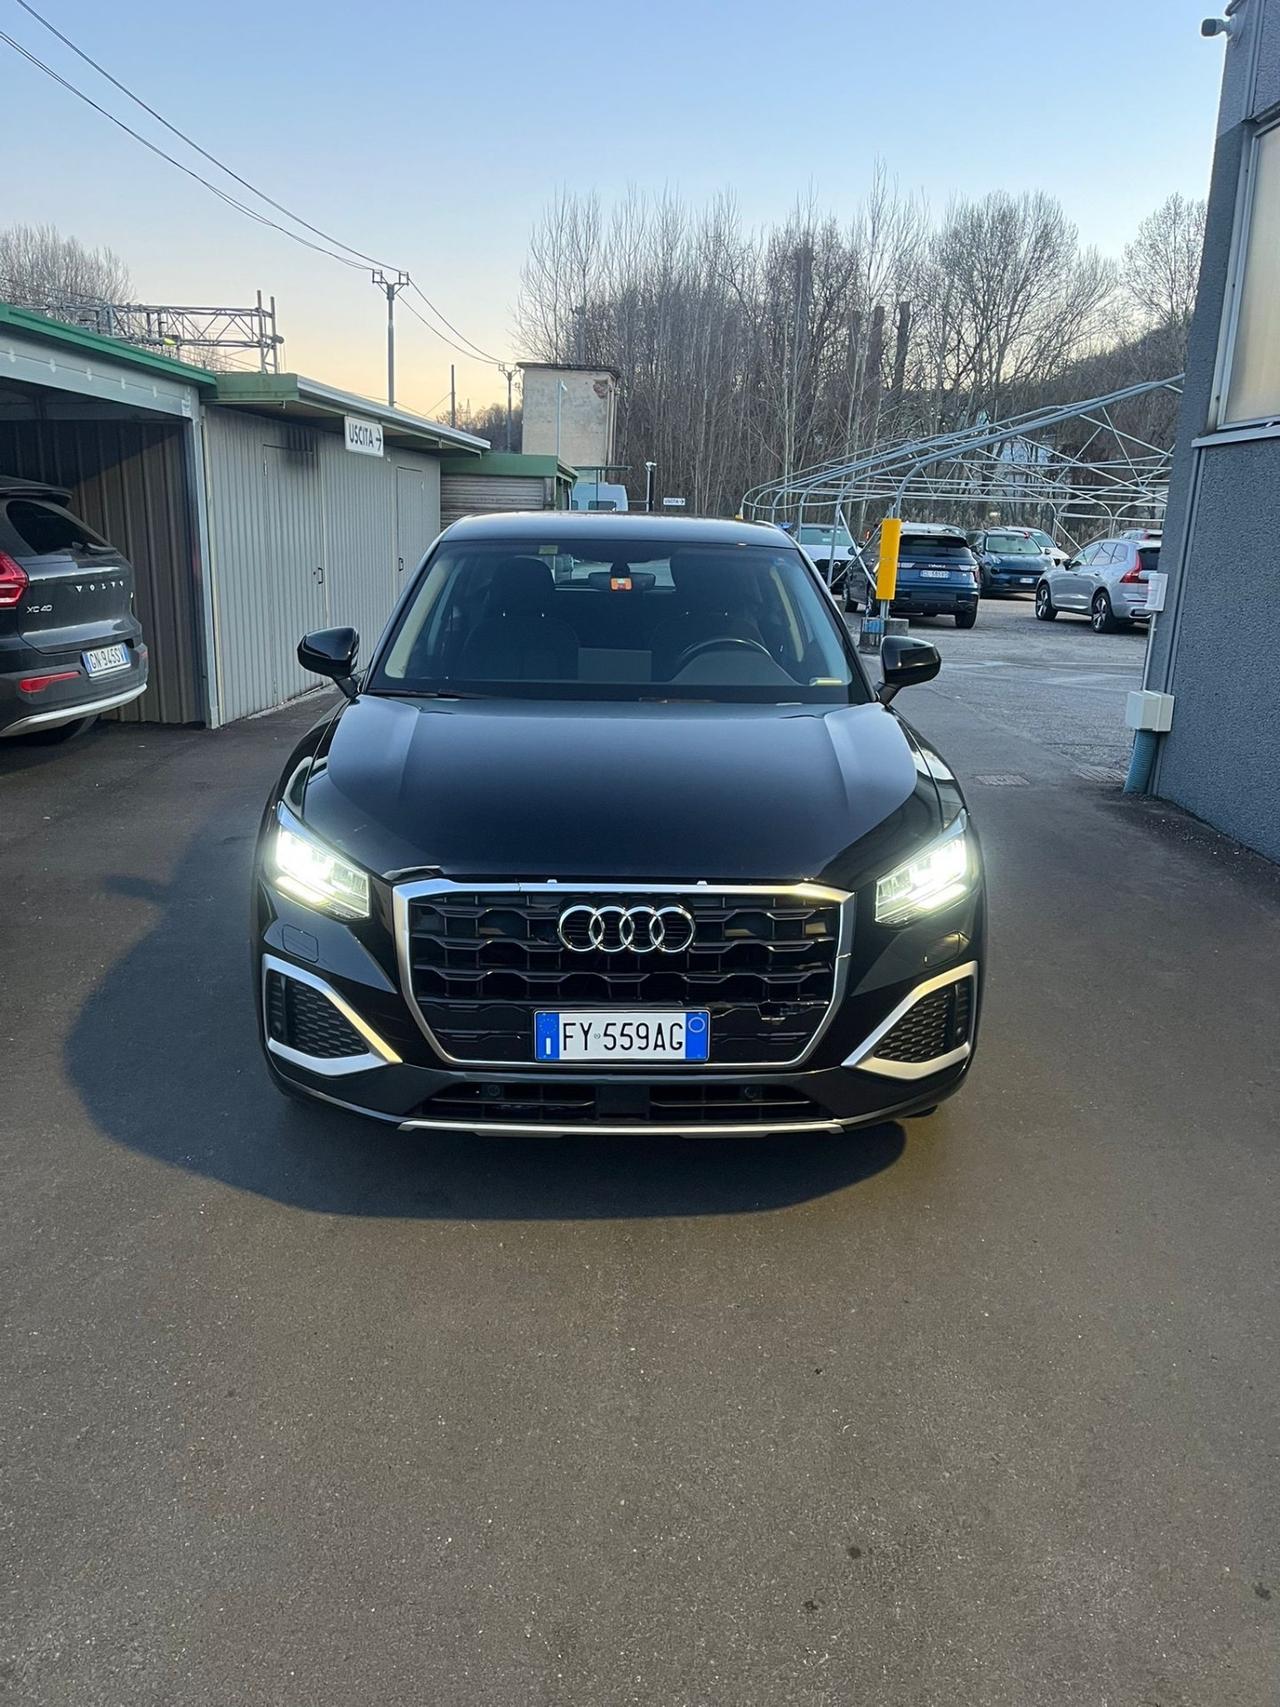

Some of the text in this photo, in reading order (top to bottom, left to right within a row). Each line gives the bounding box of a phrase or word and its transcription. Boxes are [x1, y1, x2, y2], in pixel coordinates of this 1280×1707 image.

[349, 423, 374, 448] USCITA
[562, 1022, 593, 1052] FY
[603, 1022, 684, 1052] 559AG
